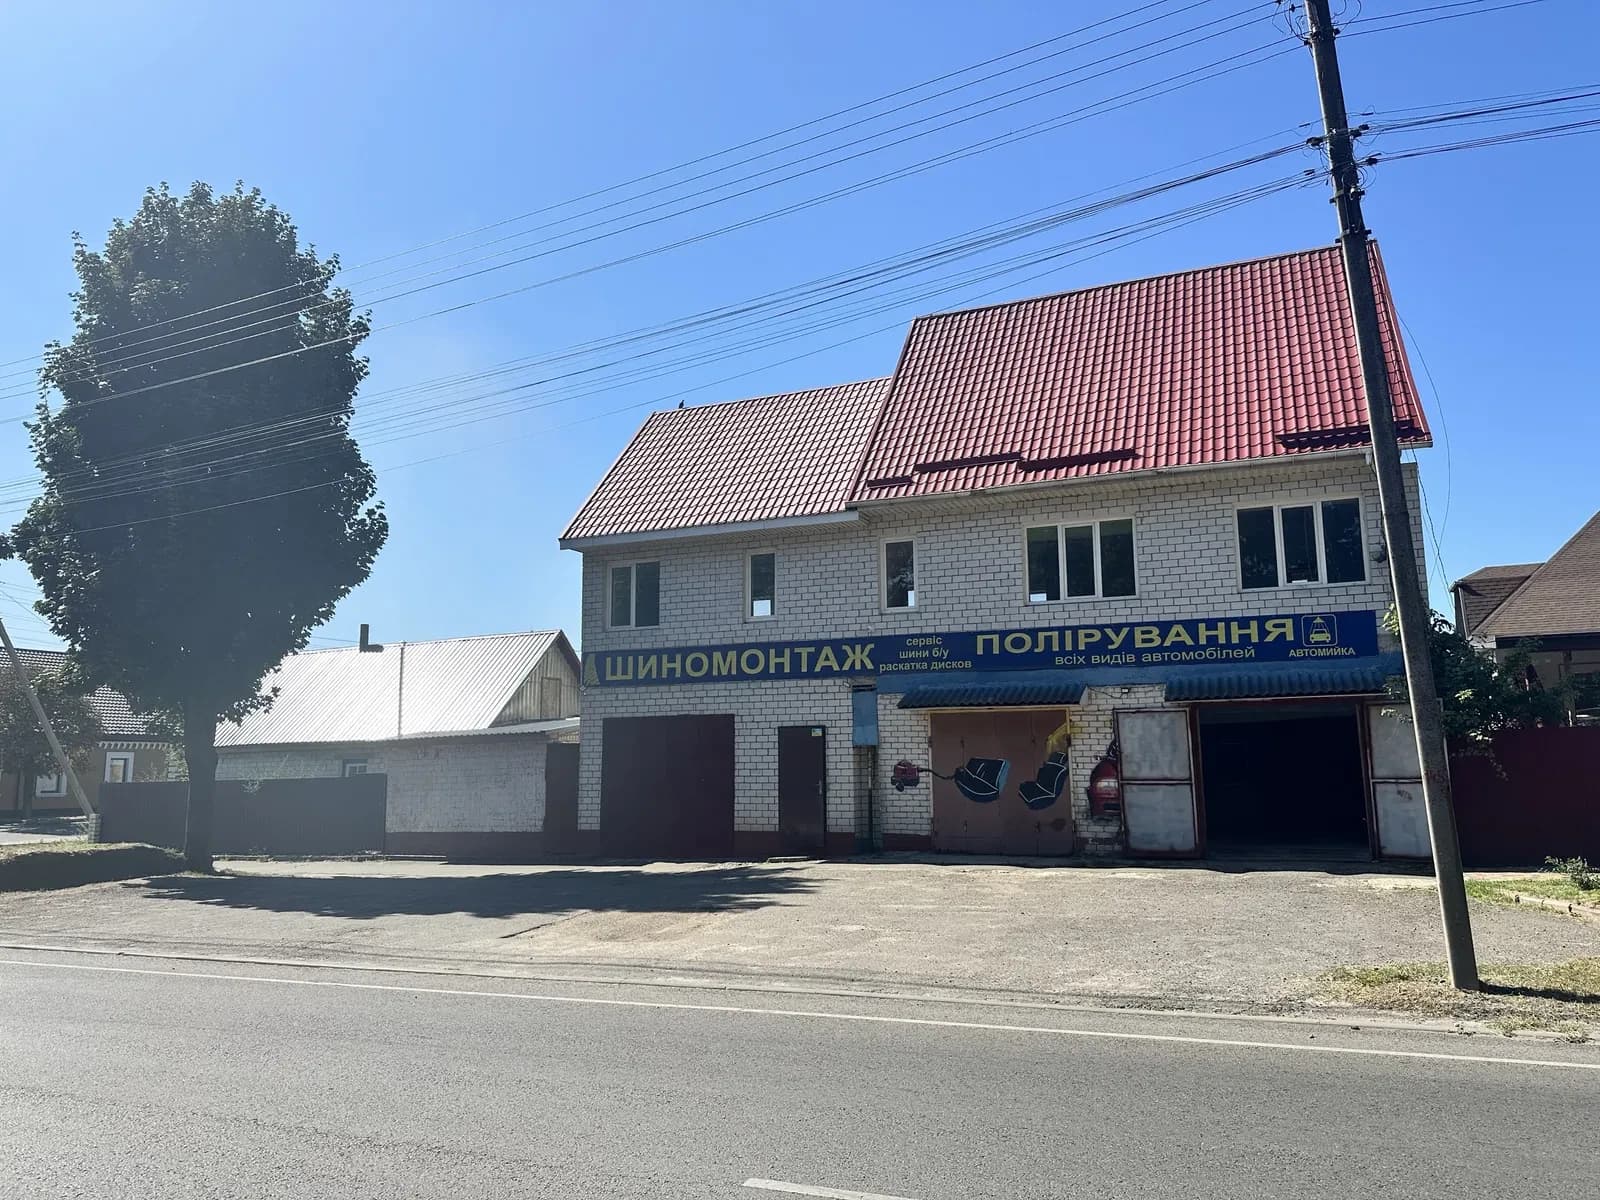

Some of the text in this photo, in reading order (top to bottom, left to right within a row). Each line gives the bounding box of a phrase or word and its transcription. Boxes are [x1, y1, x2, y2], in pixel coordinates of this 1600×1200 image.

[906, 636, 943, 647] сервіс
[976, 618, 1294, 655] ПОЛІРУВАННЯ
[900, 648, 949, 659] шини б/у
[1055, 647, 1255, 665] всіх видів автомобілей
[1289, 646, 1356, 657] АВТОМИЙКА
[605, 643, 875, 681] ШИНОМОНТАЖ
[880, 661, 972, 673] раскатка дисков
